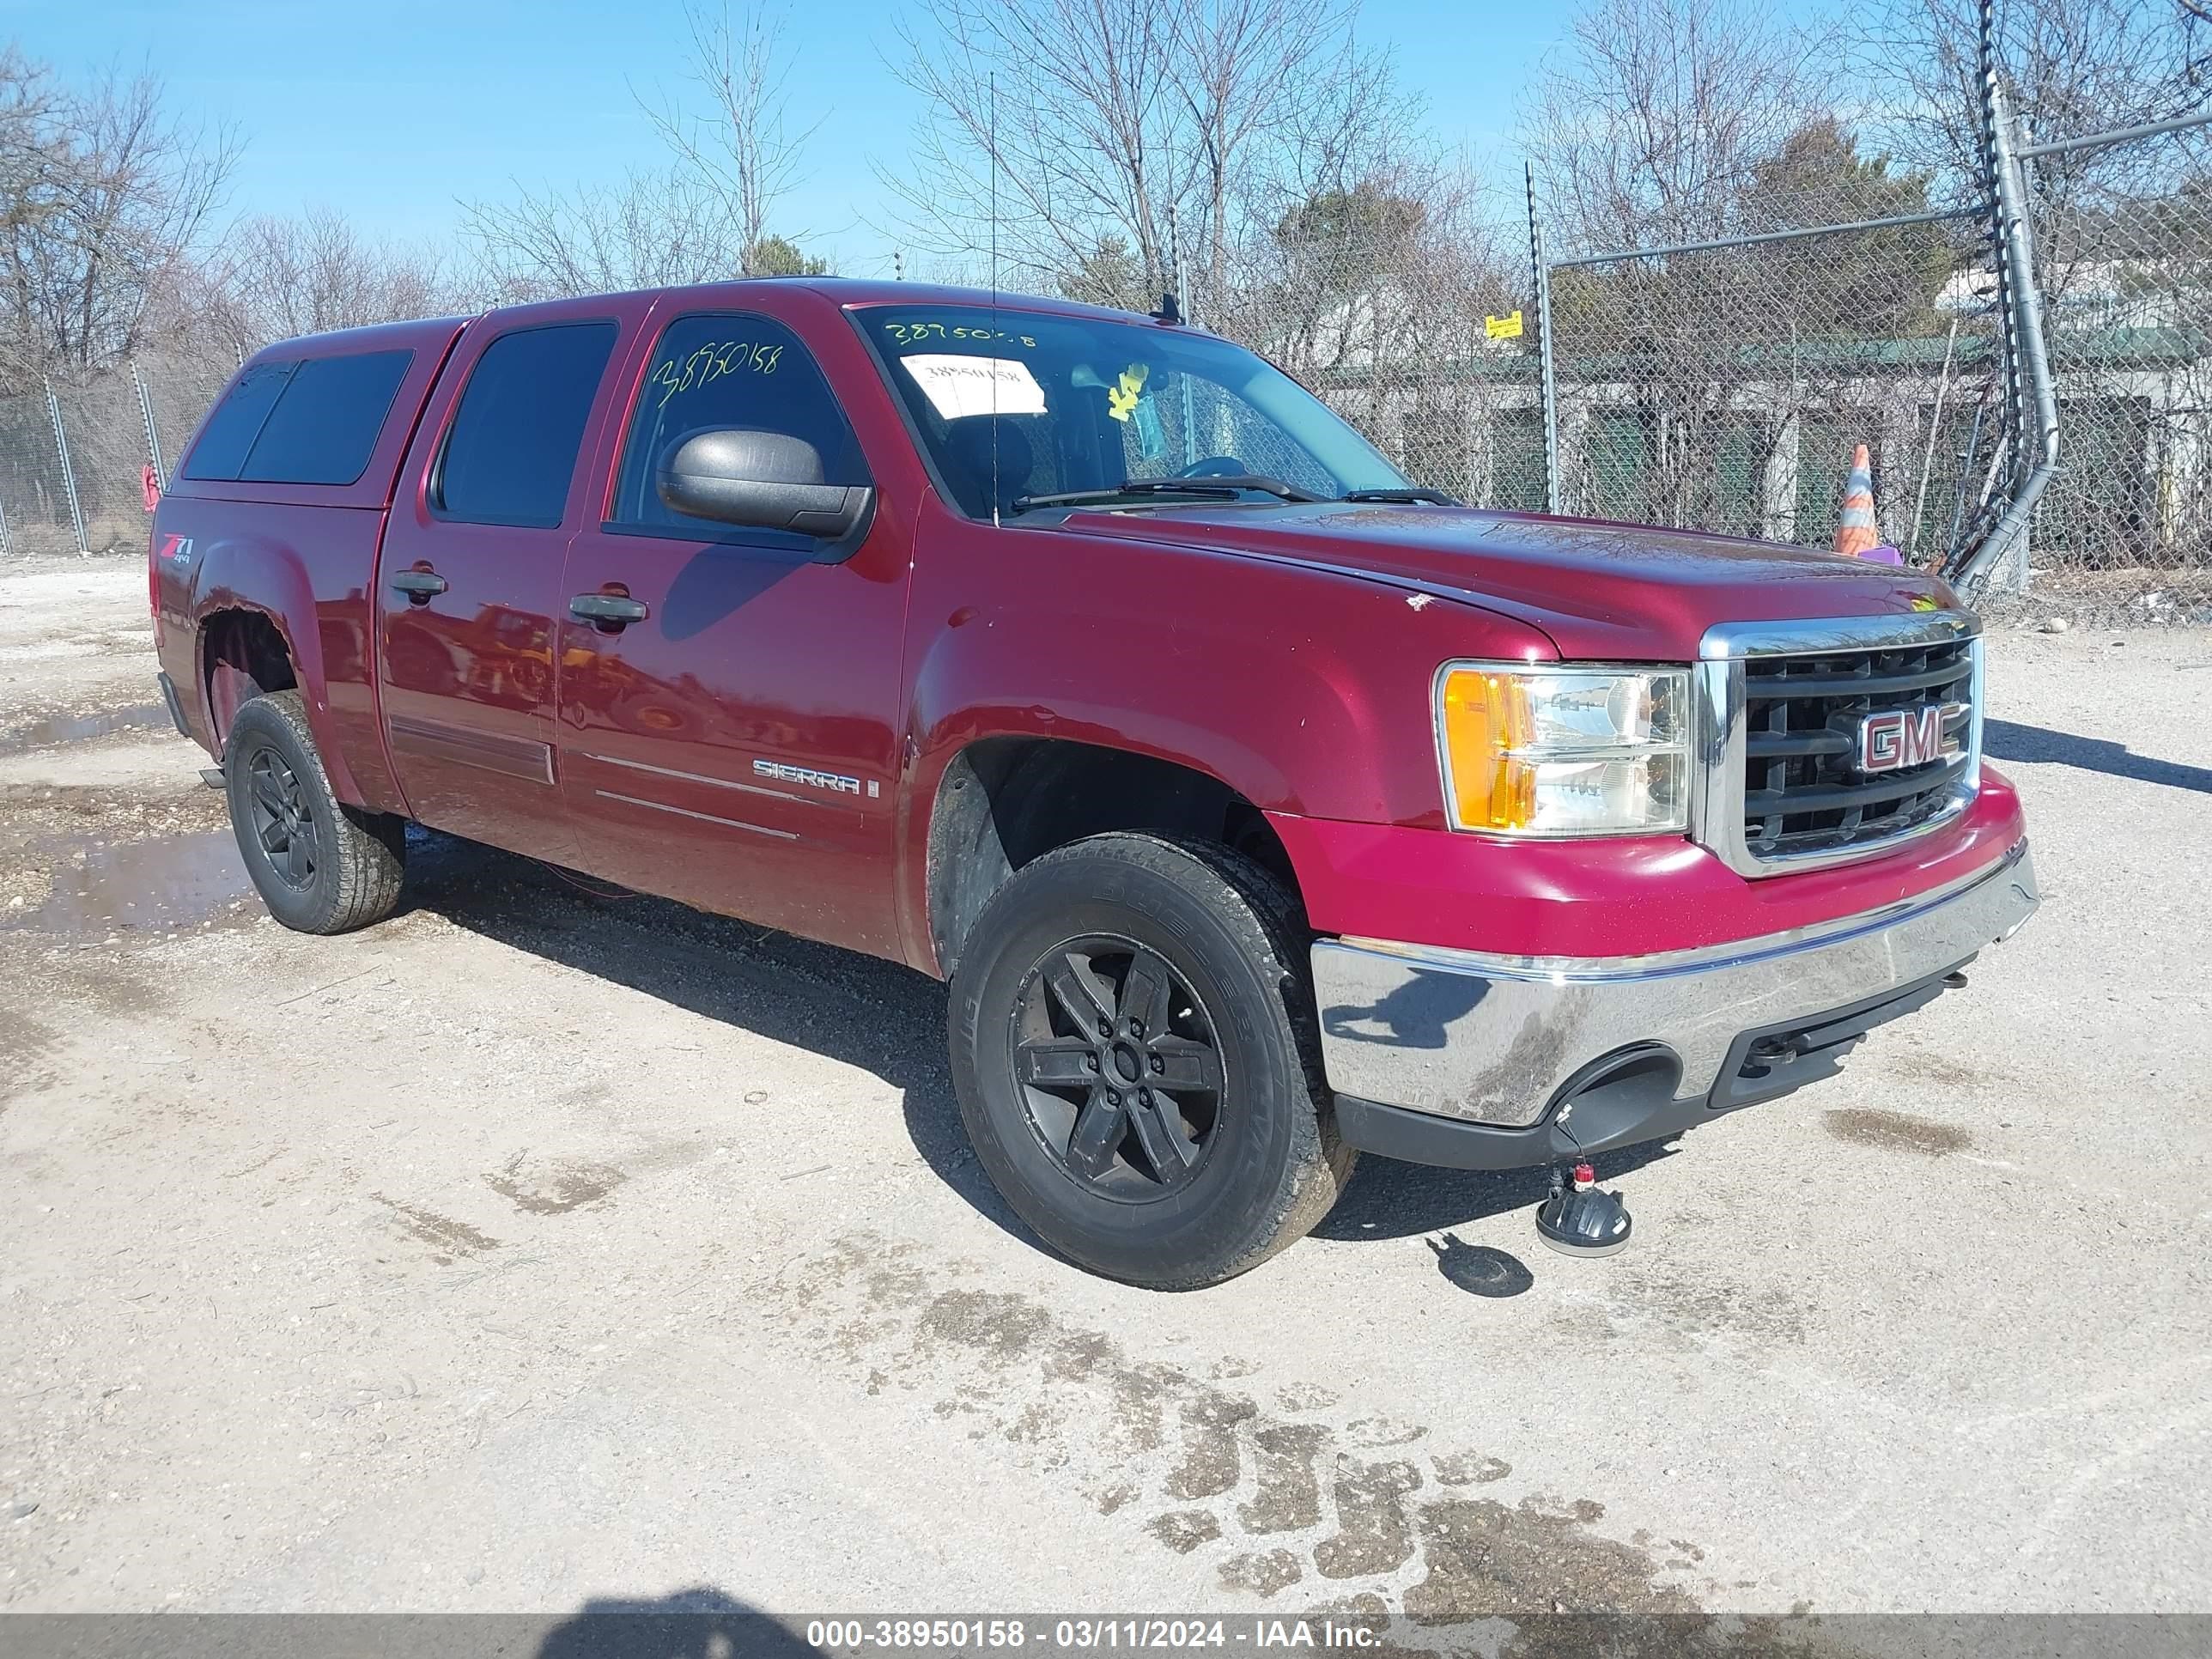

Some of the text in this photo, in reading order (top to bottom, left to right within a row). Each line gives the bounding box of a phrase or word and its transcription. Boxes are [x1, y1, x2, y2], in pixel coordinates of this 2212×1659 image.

[653, 341, 784, 409] 38950158
[161, 532, 194, 558] Z71
[1860, 701, 1961, 773] GMC
[752, 759, 860, 795] SIERRA
